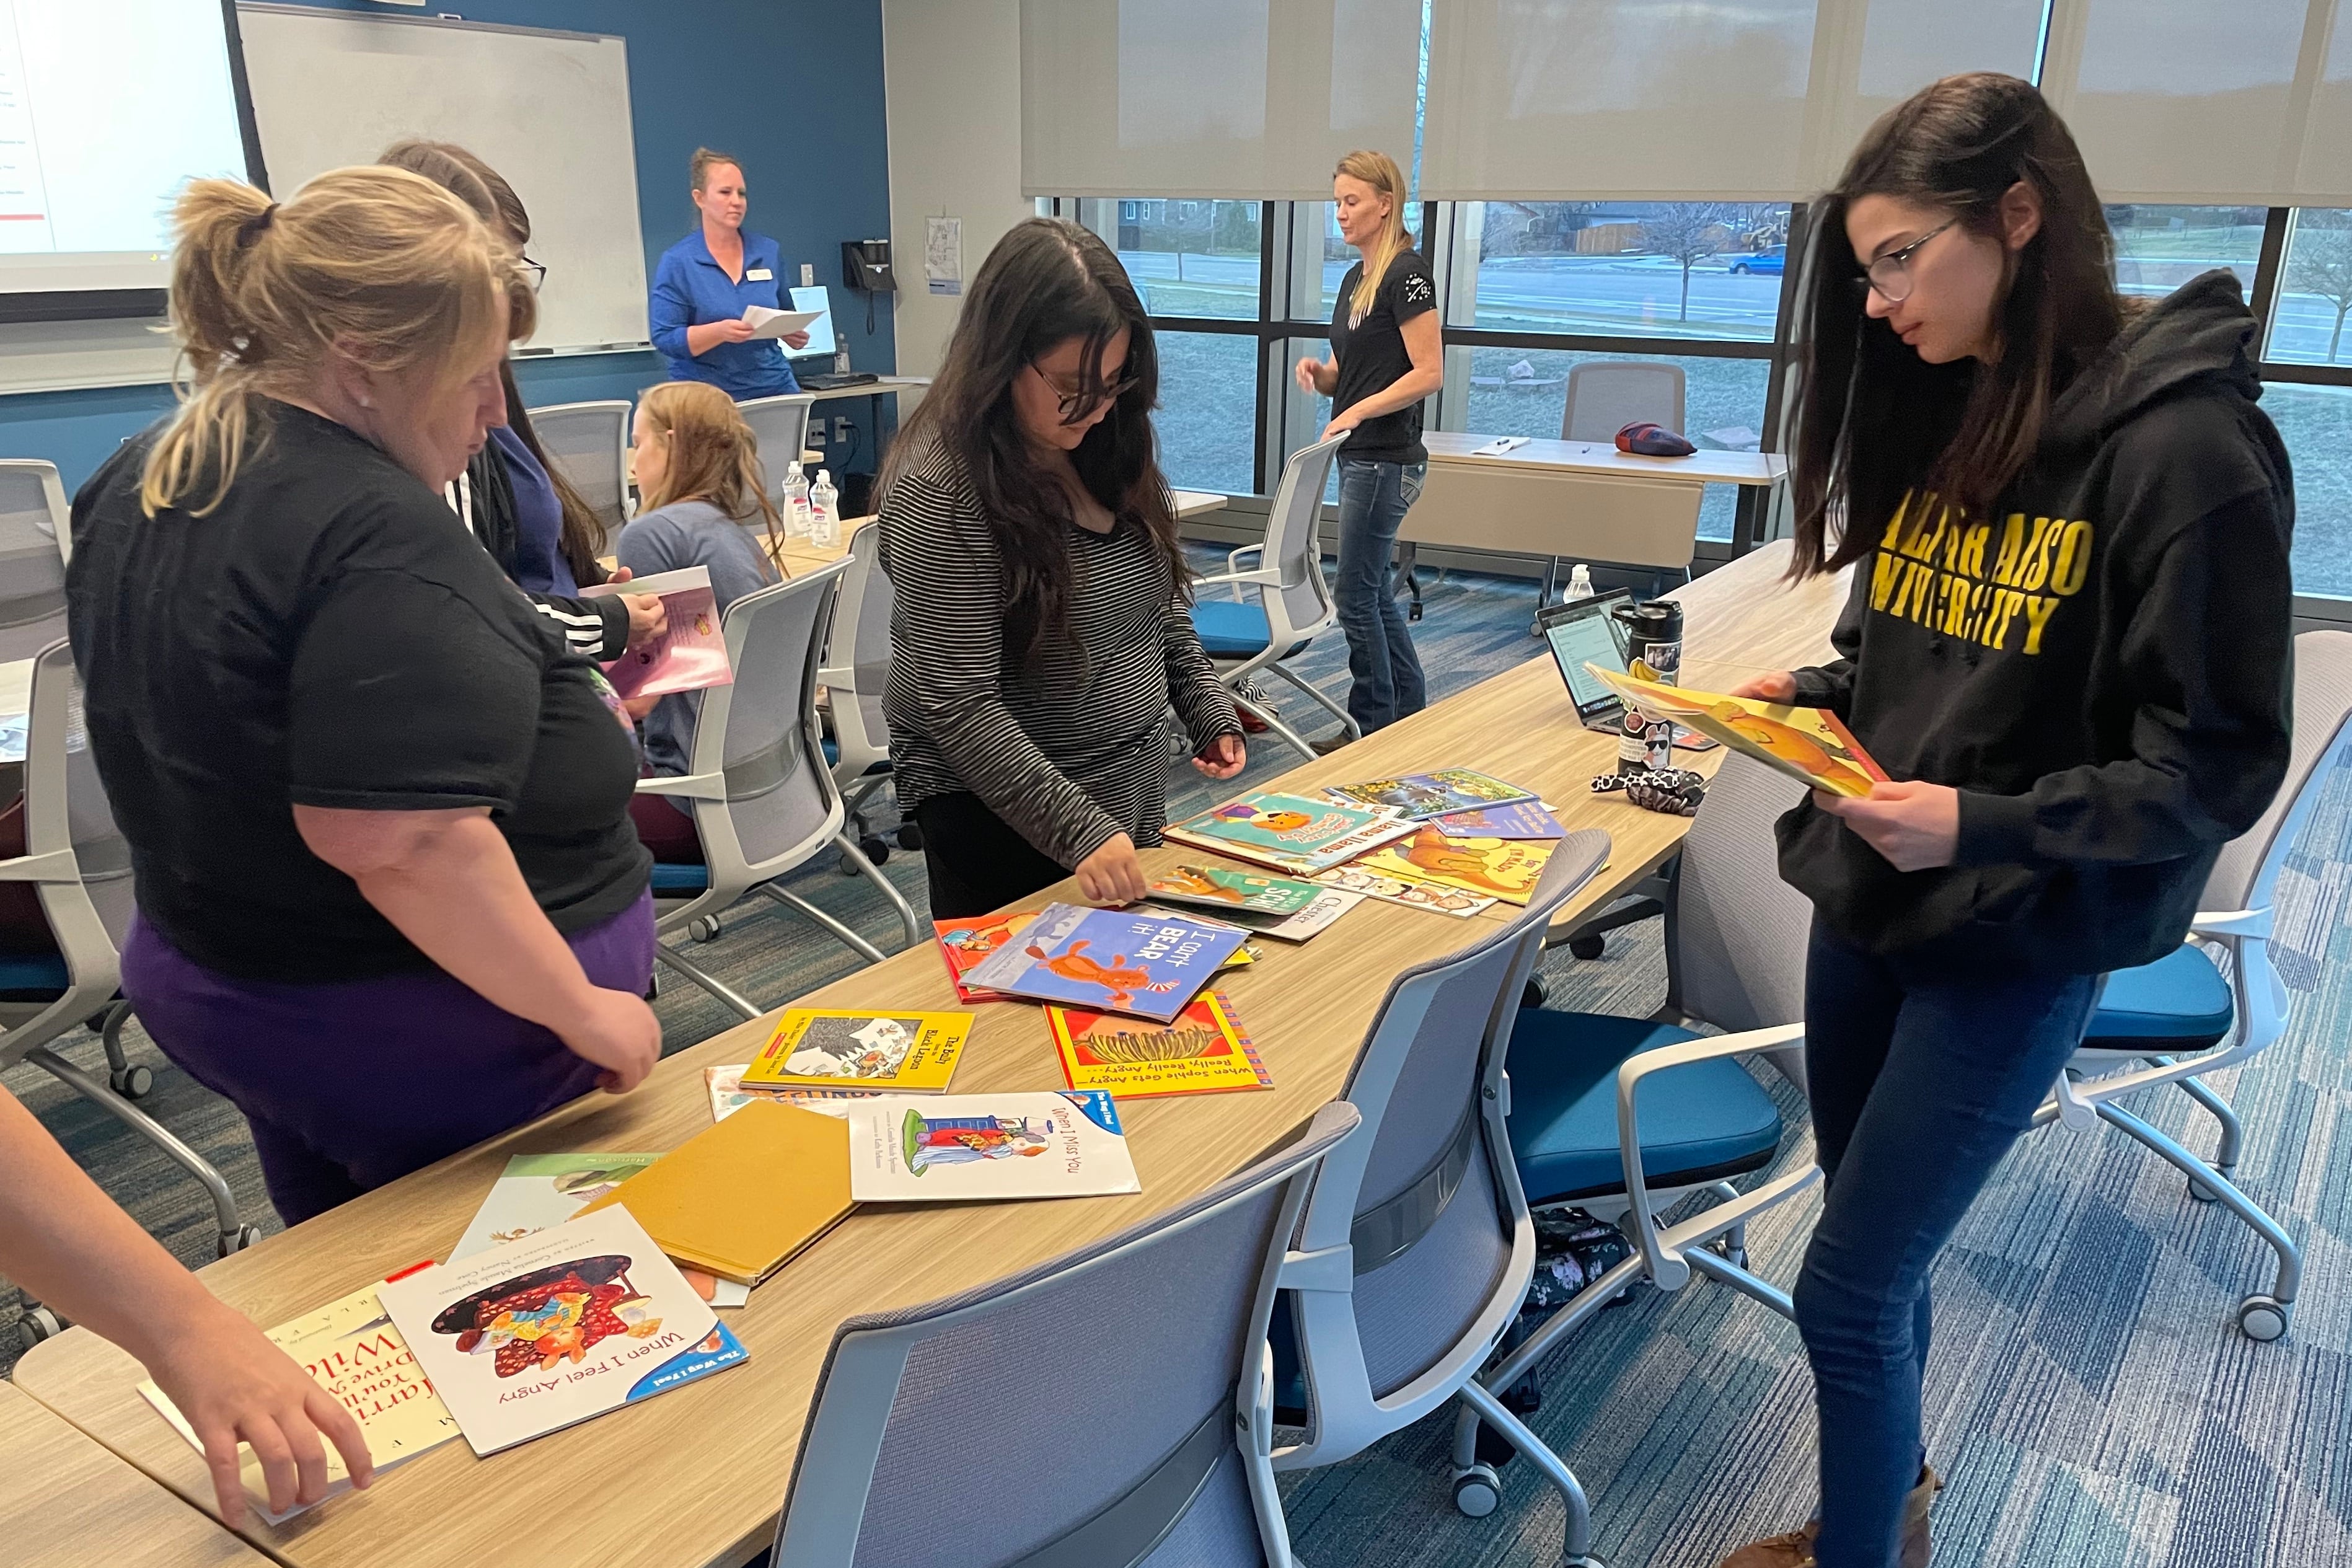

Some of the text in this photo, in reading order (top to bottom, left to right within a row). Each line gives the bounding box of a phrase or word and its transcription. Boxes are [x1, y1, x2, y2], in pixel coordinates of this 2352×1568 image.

[1357, 820, 1406, 837] llama
[1317, 836, 1368, 854] llama
[1295, 897, 1342, 923] Chester
[1127, 922, 1158, 935] it!
[1190, 930, 1216, 942] I
[1134, 927, 1187, 960] BEAR
[910, 1029, 939, 1070] Black Lagoon
[935, 1036, 959, 1065] The Bully
[1148, 1063, 1186, 1072] Really
[1188, 1059, 1232, 1068] Really,
[1214, 1067, 1251, 1075] When
[1132, 1074, 1161, 1082] Gets
[1166, 1070, 1209, 1080] Sophie
[1052, 1108, 1071, 1129] When
[1062, 1136, 1080, 1155] Miss
[1065, 1157, 1081, 1173] You
[304, 1333, 407, 1379] Wil
[716, 1350, 741, 1362] The
[350, 1351, 415, 1383] Drive
[499, 1332, 685, 1405] When I Feel Angry
[687, 1359, 718, 1373] Way
[653, 1374, 680, 1386] Feel
[342, 1373, 411, 1408] You'll
[355, 1378, 434, 1425] arri
